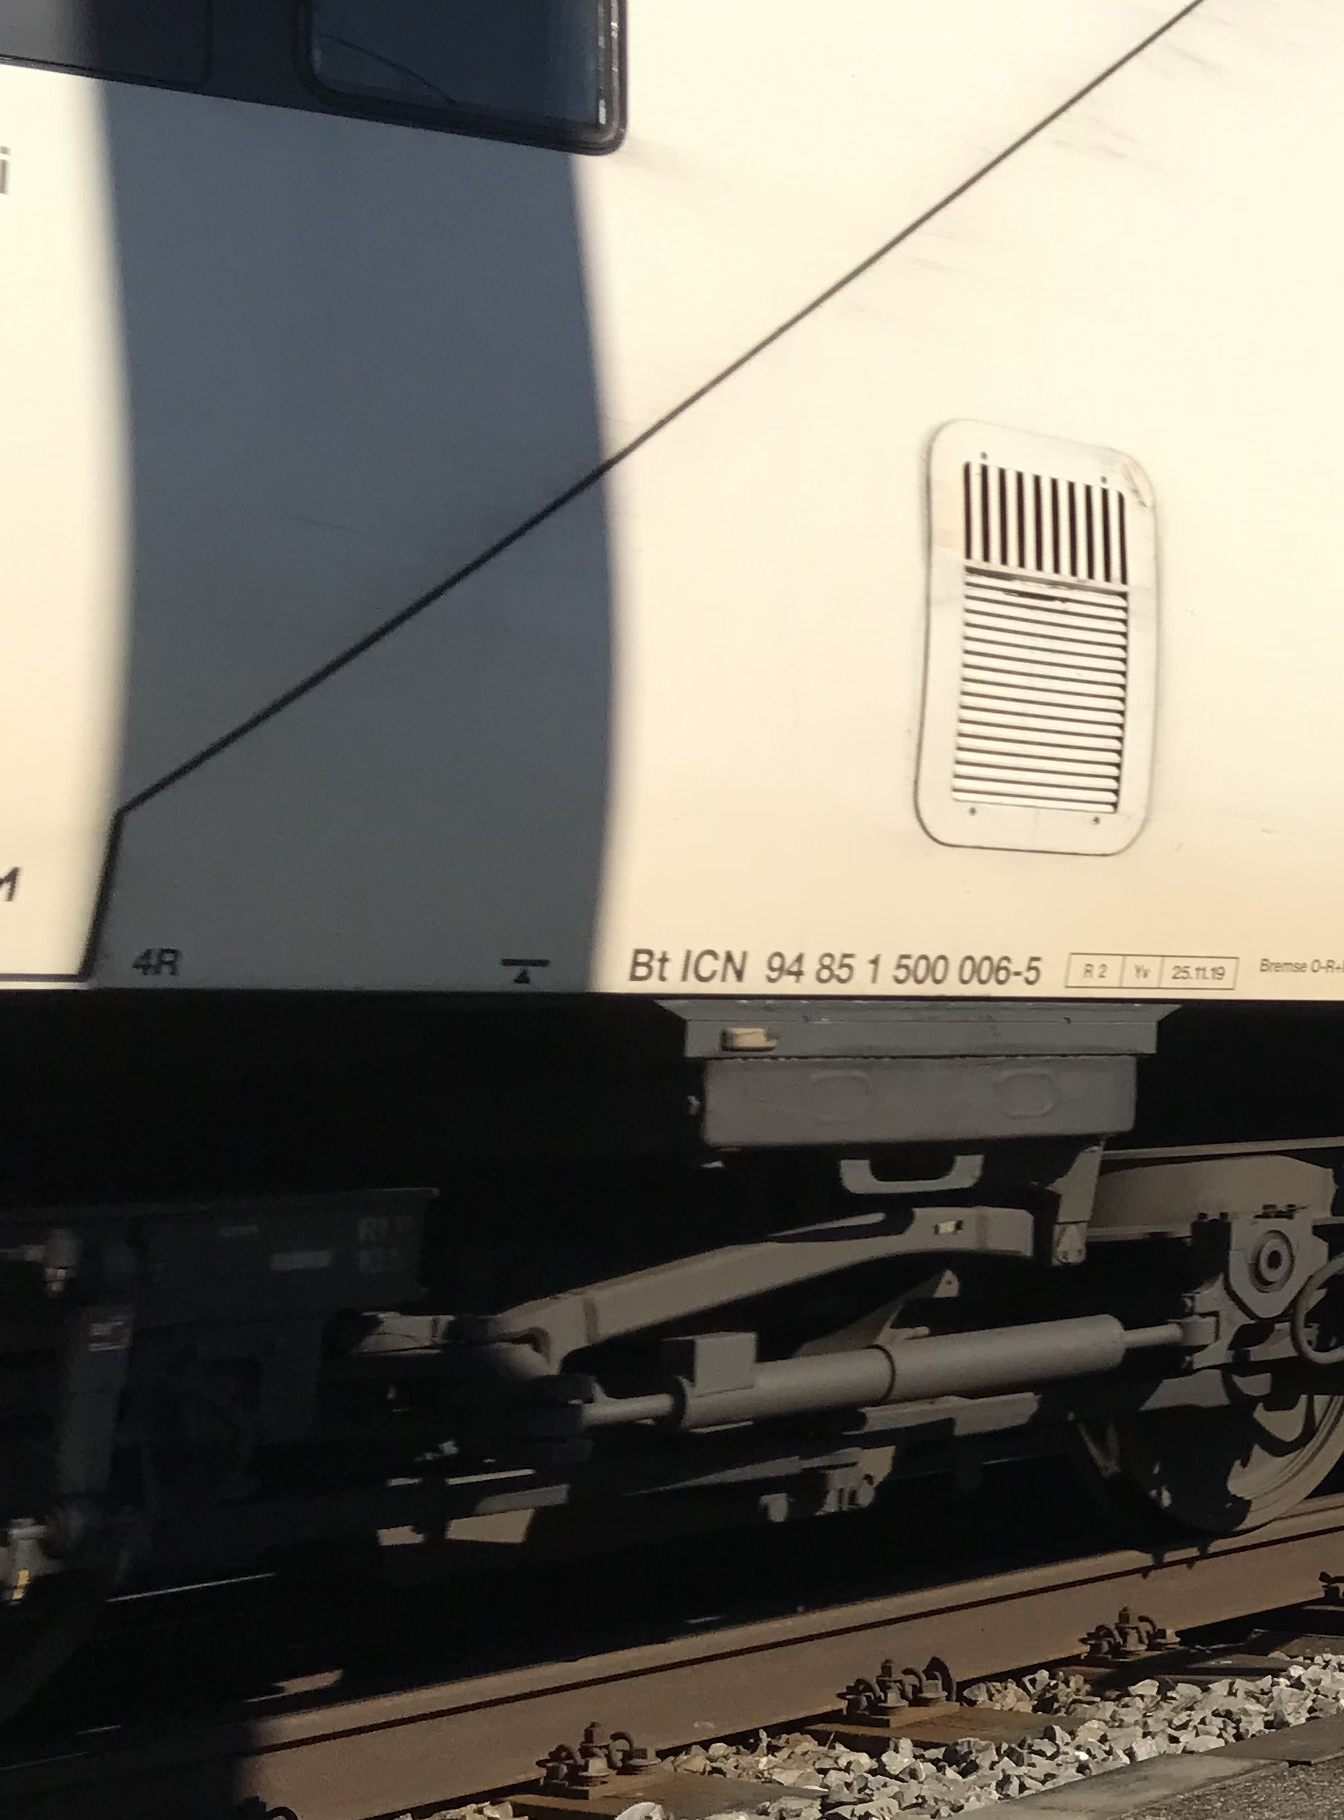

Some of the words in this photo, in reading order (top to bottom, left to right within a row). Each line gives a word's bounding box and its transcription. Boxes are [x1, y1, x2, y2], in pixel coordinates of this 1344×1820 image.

[132, 948, 182, 976] 4R
[628, 948, 670, 982] Bt
[680, 949, 747, 983] ICN
[765, 951, 805, 984] 94
[815, 952, 856, 984] 85
[867, 953, 881, 984] 1
[893, 953, 949, 985] 500
[958, 954, 1042, 986] 006-5
[1083, 963, 1093, 978] R
[1098, 964, 1107, 979] 2
[1171, 965, 1226, 981] 25.11.19
[1260, 958, 1308, 973] Bremse
